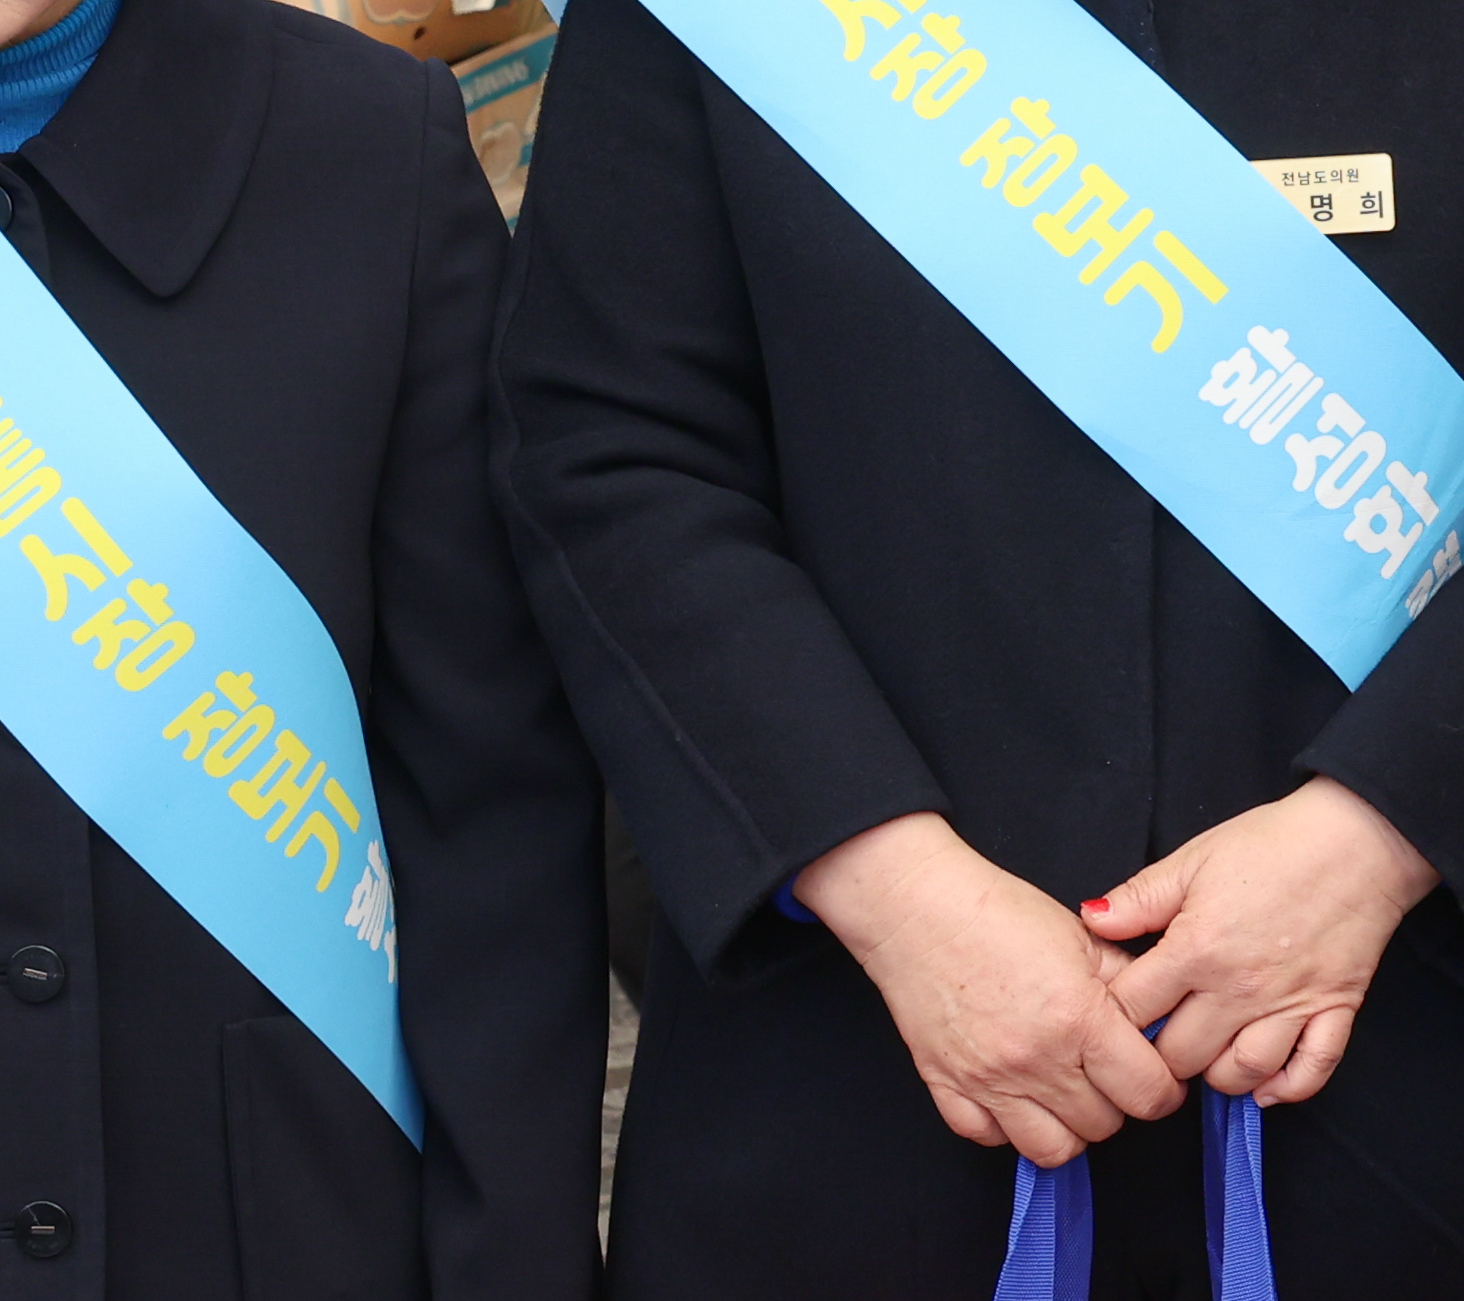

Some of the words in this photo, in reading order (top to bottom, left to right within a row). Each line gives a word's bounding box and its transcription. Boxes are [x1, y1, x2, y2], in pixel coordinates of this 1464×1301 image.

[1282, 168, 1359, 187] 전남도의원
[960, 96, 1229, 353] 장보기
[1197, 325, 1440, 580] 활성화
[162, 670, 361, 892] 장보기
